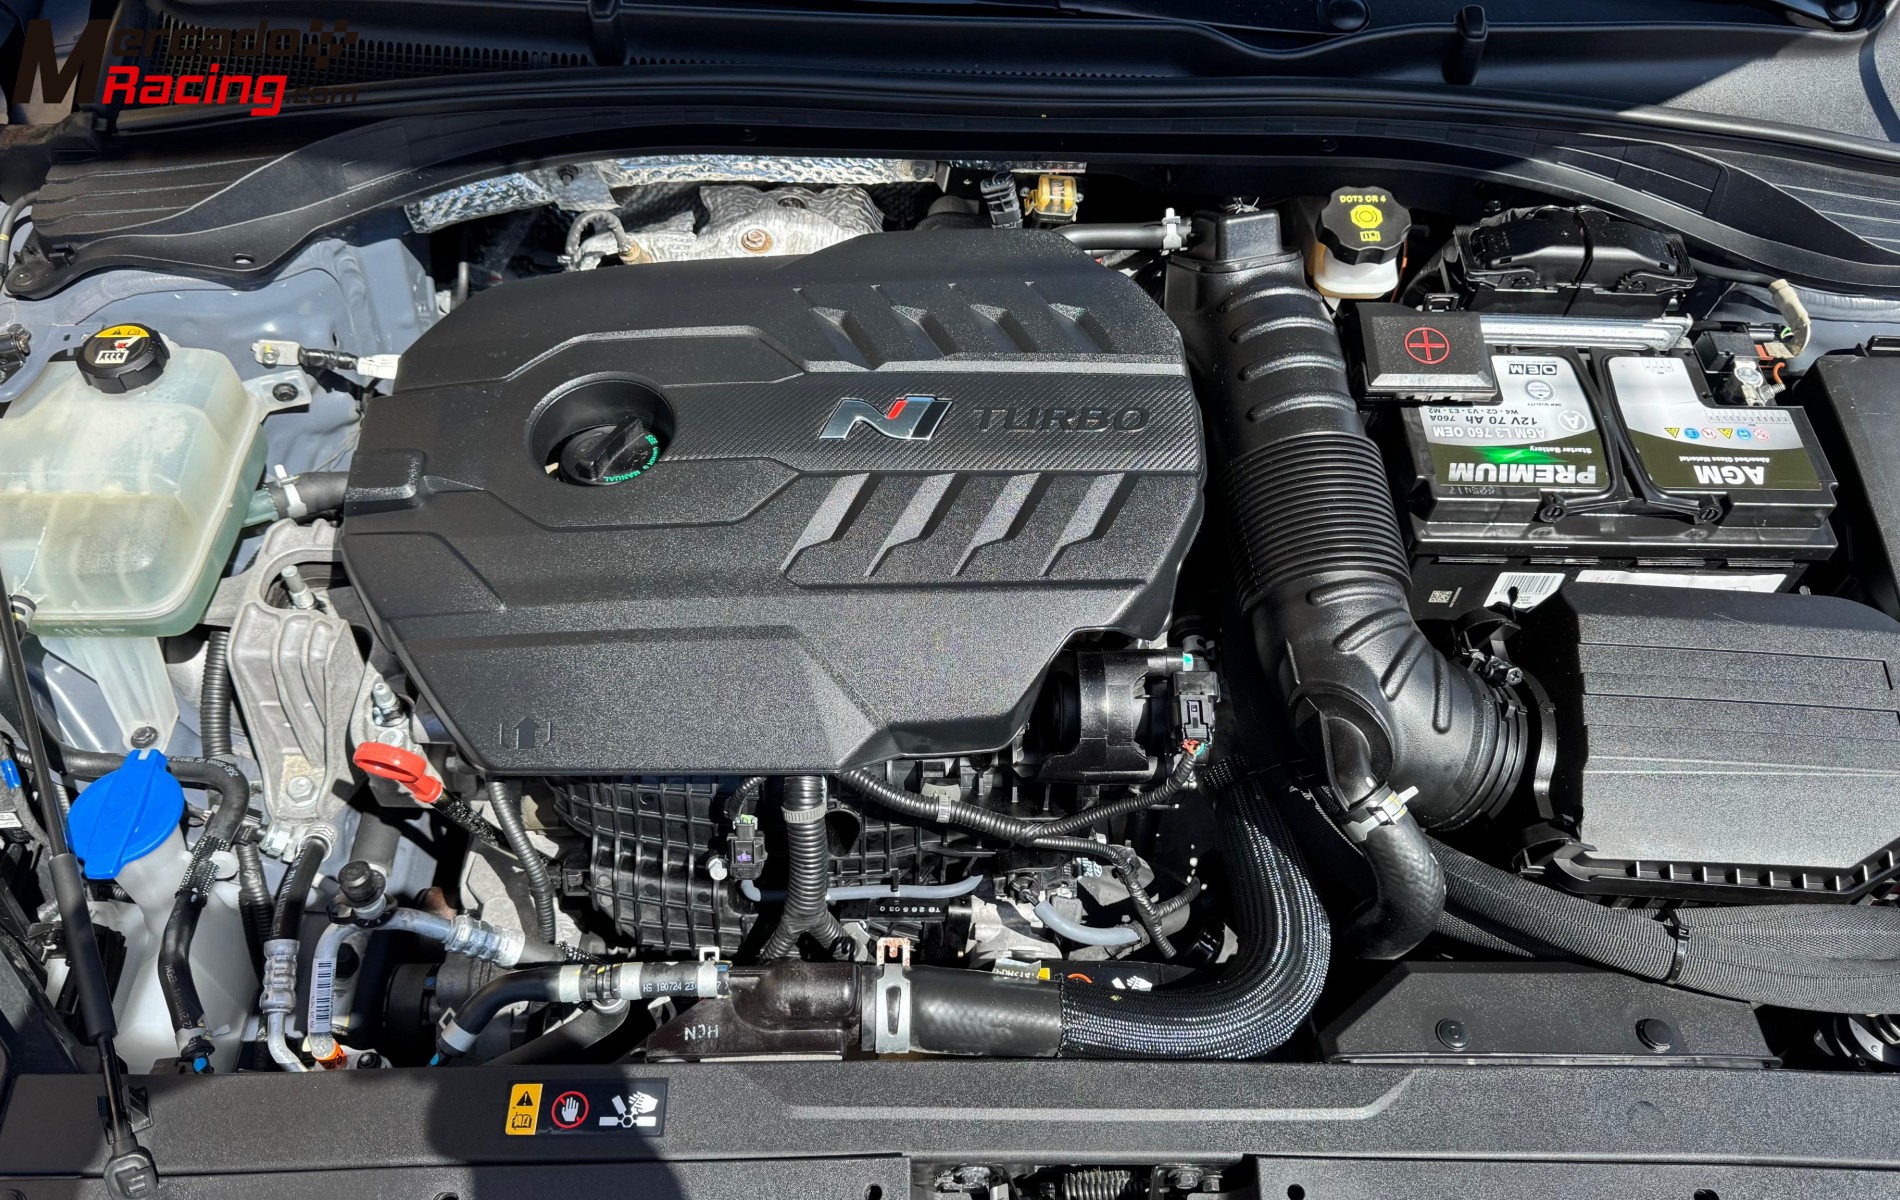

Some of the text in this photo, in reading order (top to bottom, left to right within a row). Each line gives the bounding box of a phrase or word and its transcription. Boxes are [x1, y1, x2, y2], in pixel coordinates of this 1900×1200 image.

[1339, 194, 1387, 203] DOT3 OR 4
[1507, 363, 1558, 375] OEM
[973, 406, 1150, 433] TURBO
[1429, 414, 1538, 425] 12V 70 Ah 760A
[1432, 425, 1545, 439] AGM L3 760 OEM
[1529, 445, 1593, 455] Starter Battery
[1678, 455, 1710, 463] Material
[603, 469, 641, 482] MANUAL
[1448, 462, 1596, 484] PREMIUM
[1693, 465, 1765, 485] AGM
[643, 983, 653, 992] HS
[656, 982, 682, 992] 180724
[684, 1023, 719, 1041] HCN
